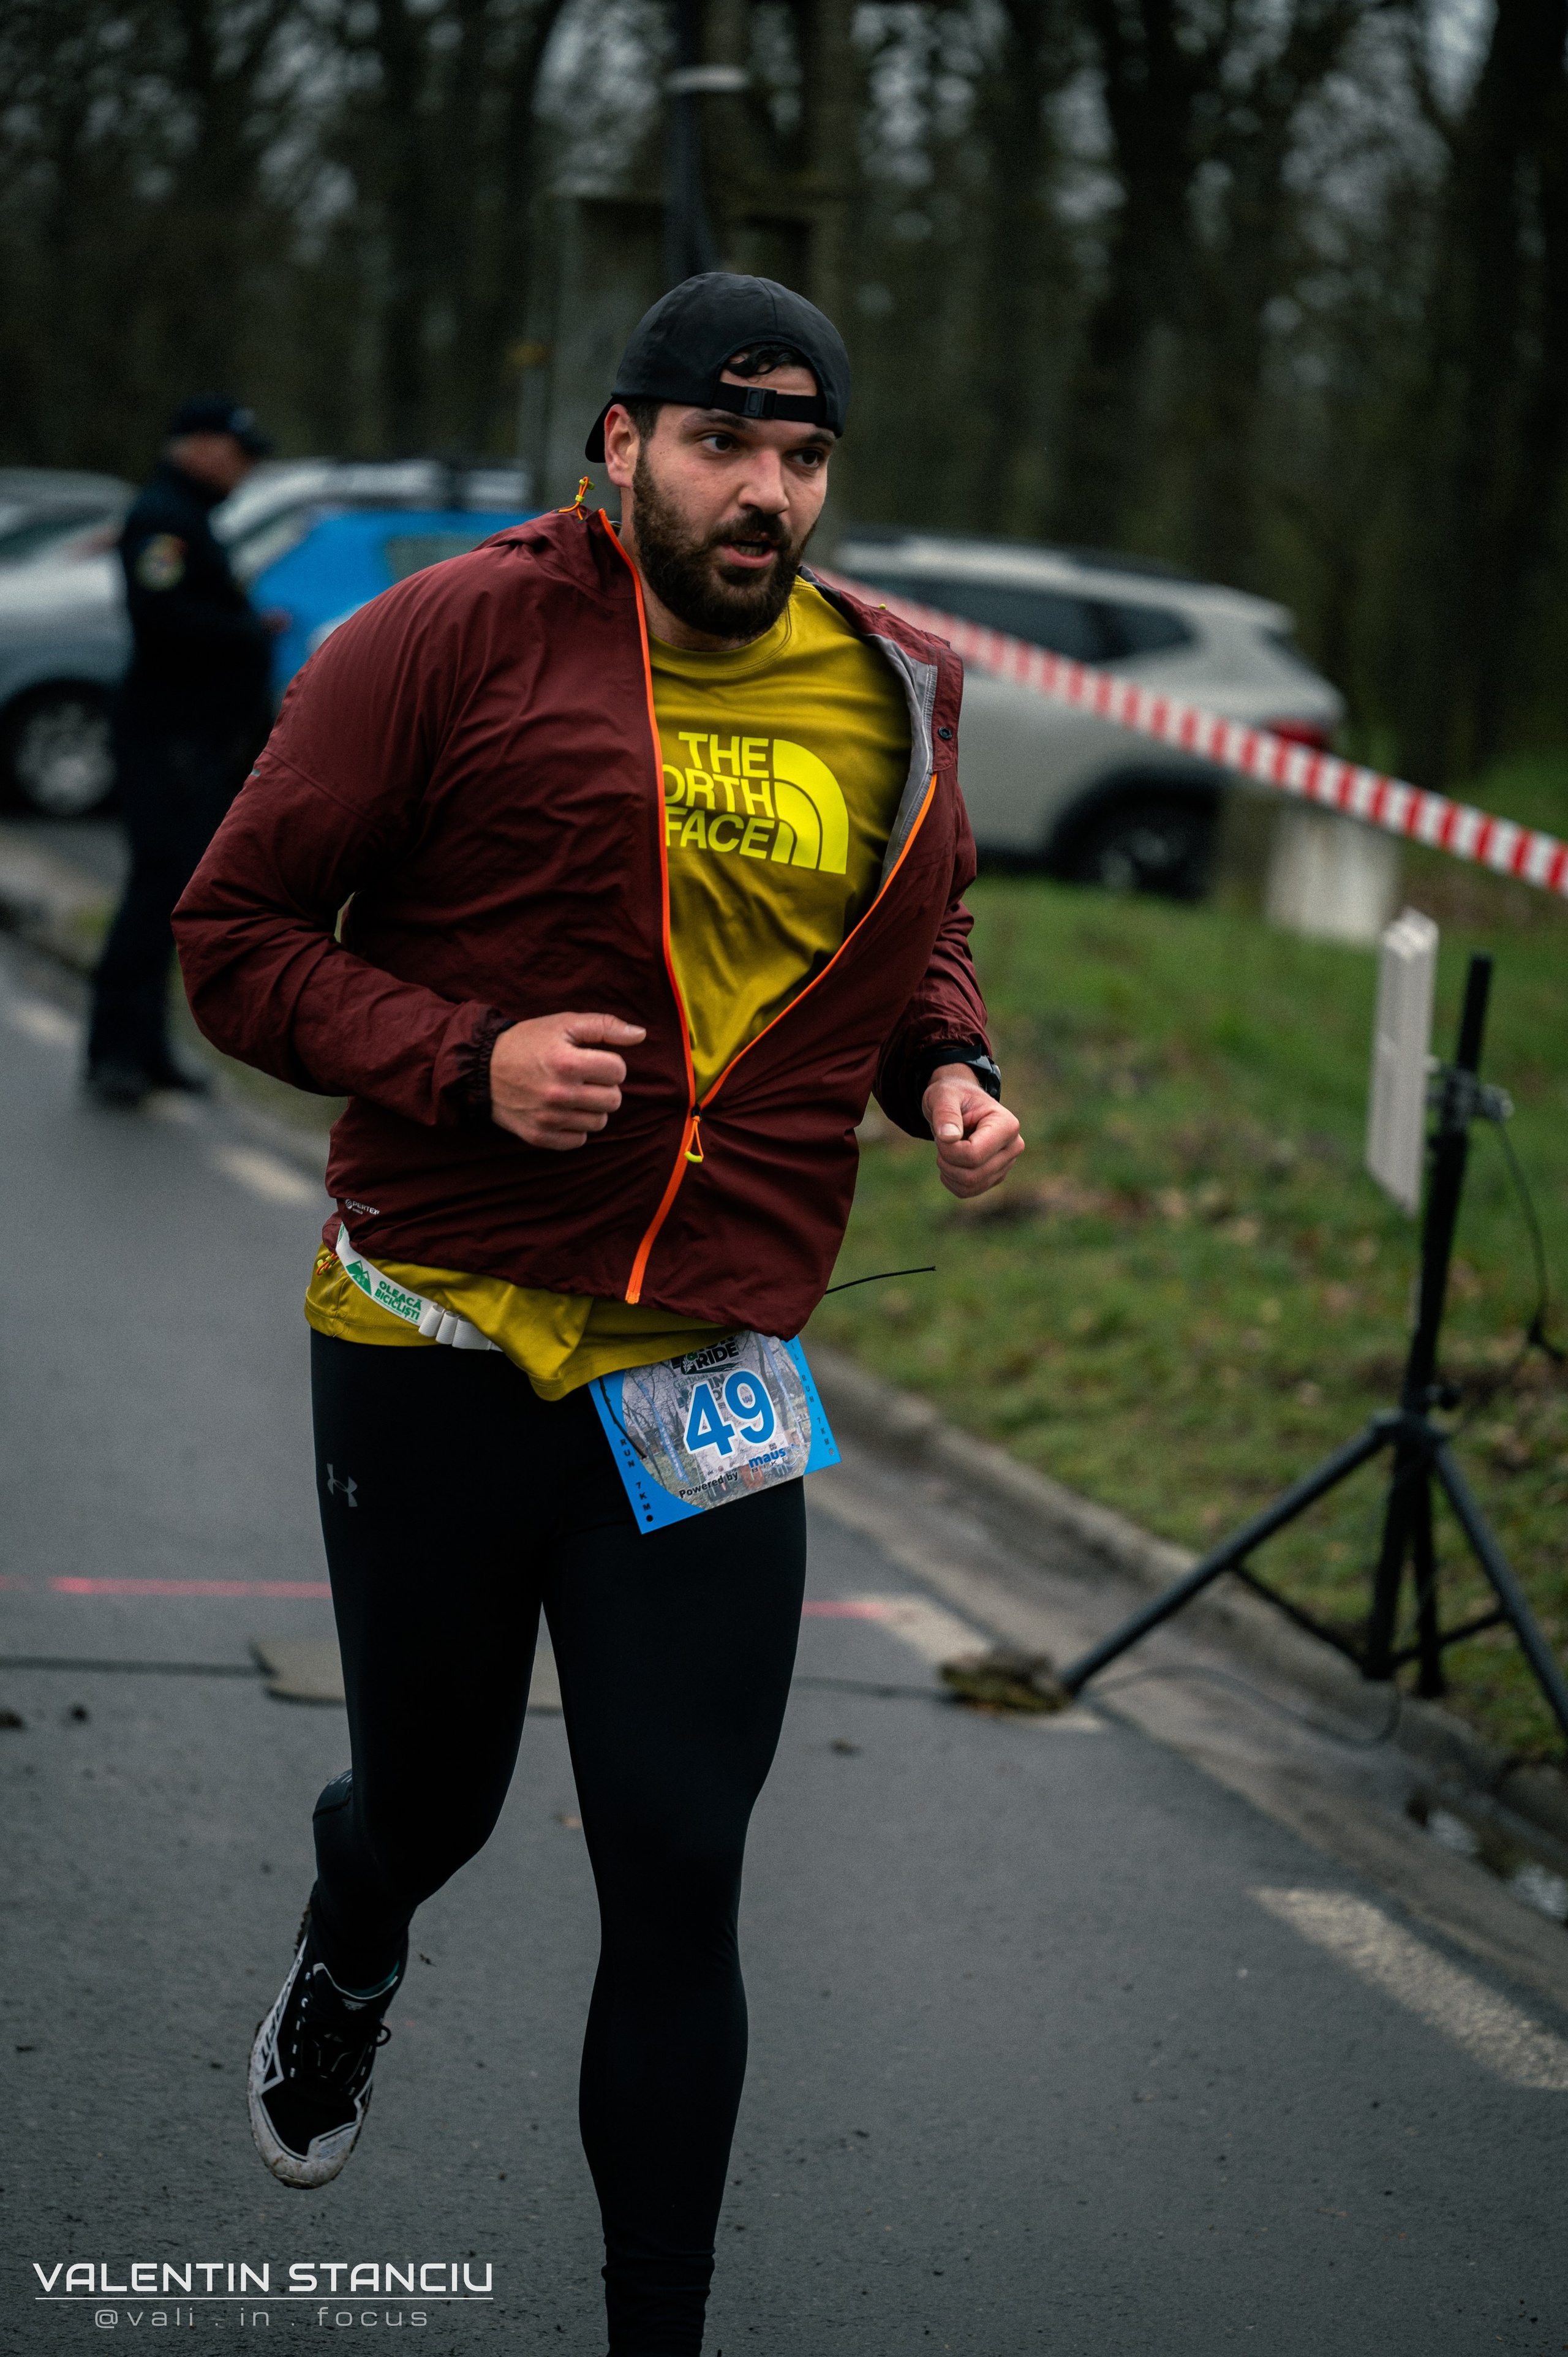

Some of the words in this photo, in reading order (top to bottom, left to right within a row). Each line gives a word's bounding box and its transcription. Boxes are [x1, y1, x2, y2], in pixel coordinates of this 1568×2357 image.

[679, 731, 769, 779] THE
[662, 764, 775, 818] ORTH
[665, 805, 775, 859] FACE
[379, 1280, 422, 1311] OLEACĂ
[696, 1341, 739, 1370] RIDE
[685, 1370, 775, 1457] 49
[620, 1439, 635, 1468] RUN
[636, 1481, 651, 1511] 7KM
[748, 1448, 786, 1468] maus
[679, 1475, 724, 1498] Powered
[726, 1471, 738, 1481] by
